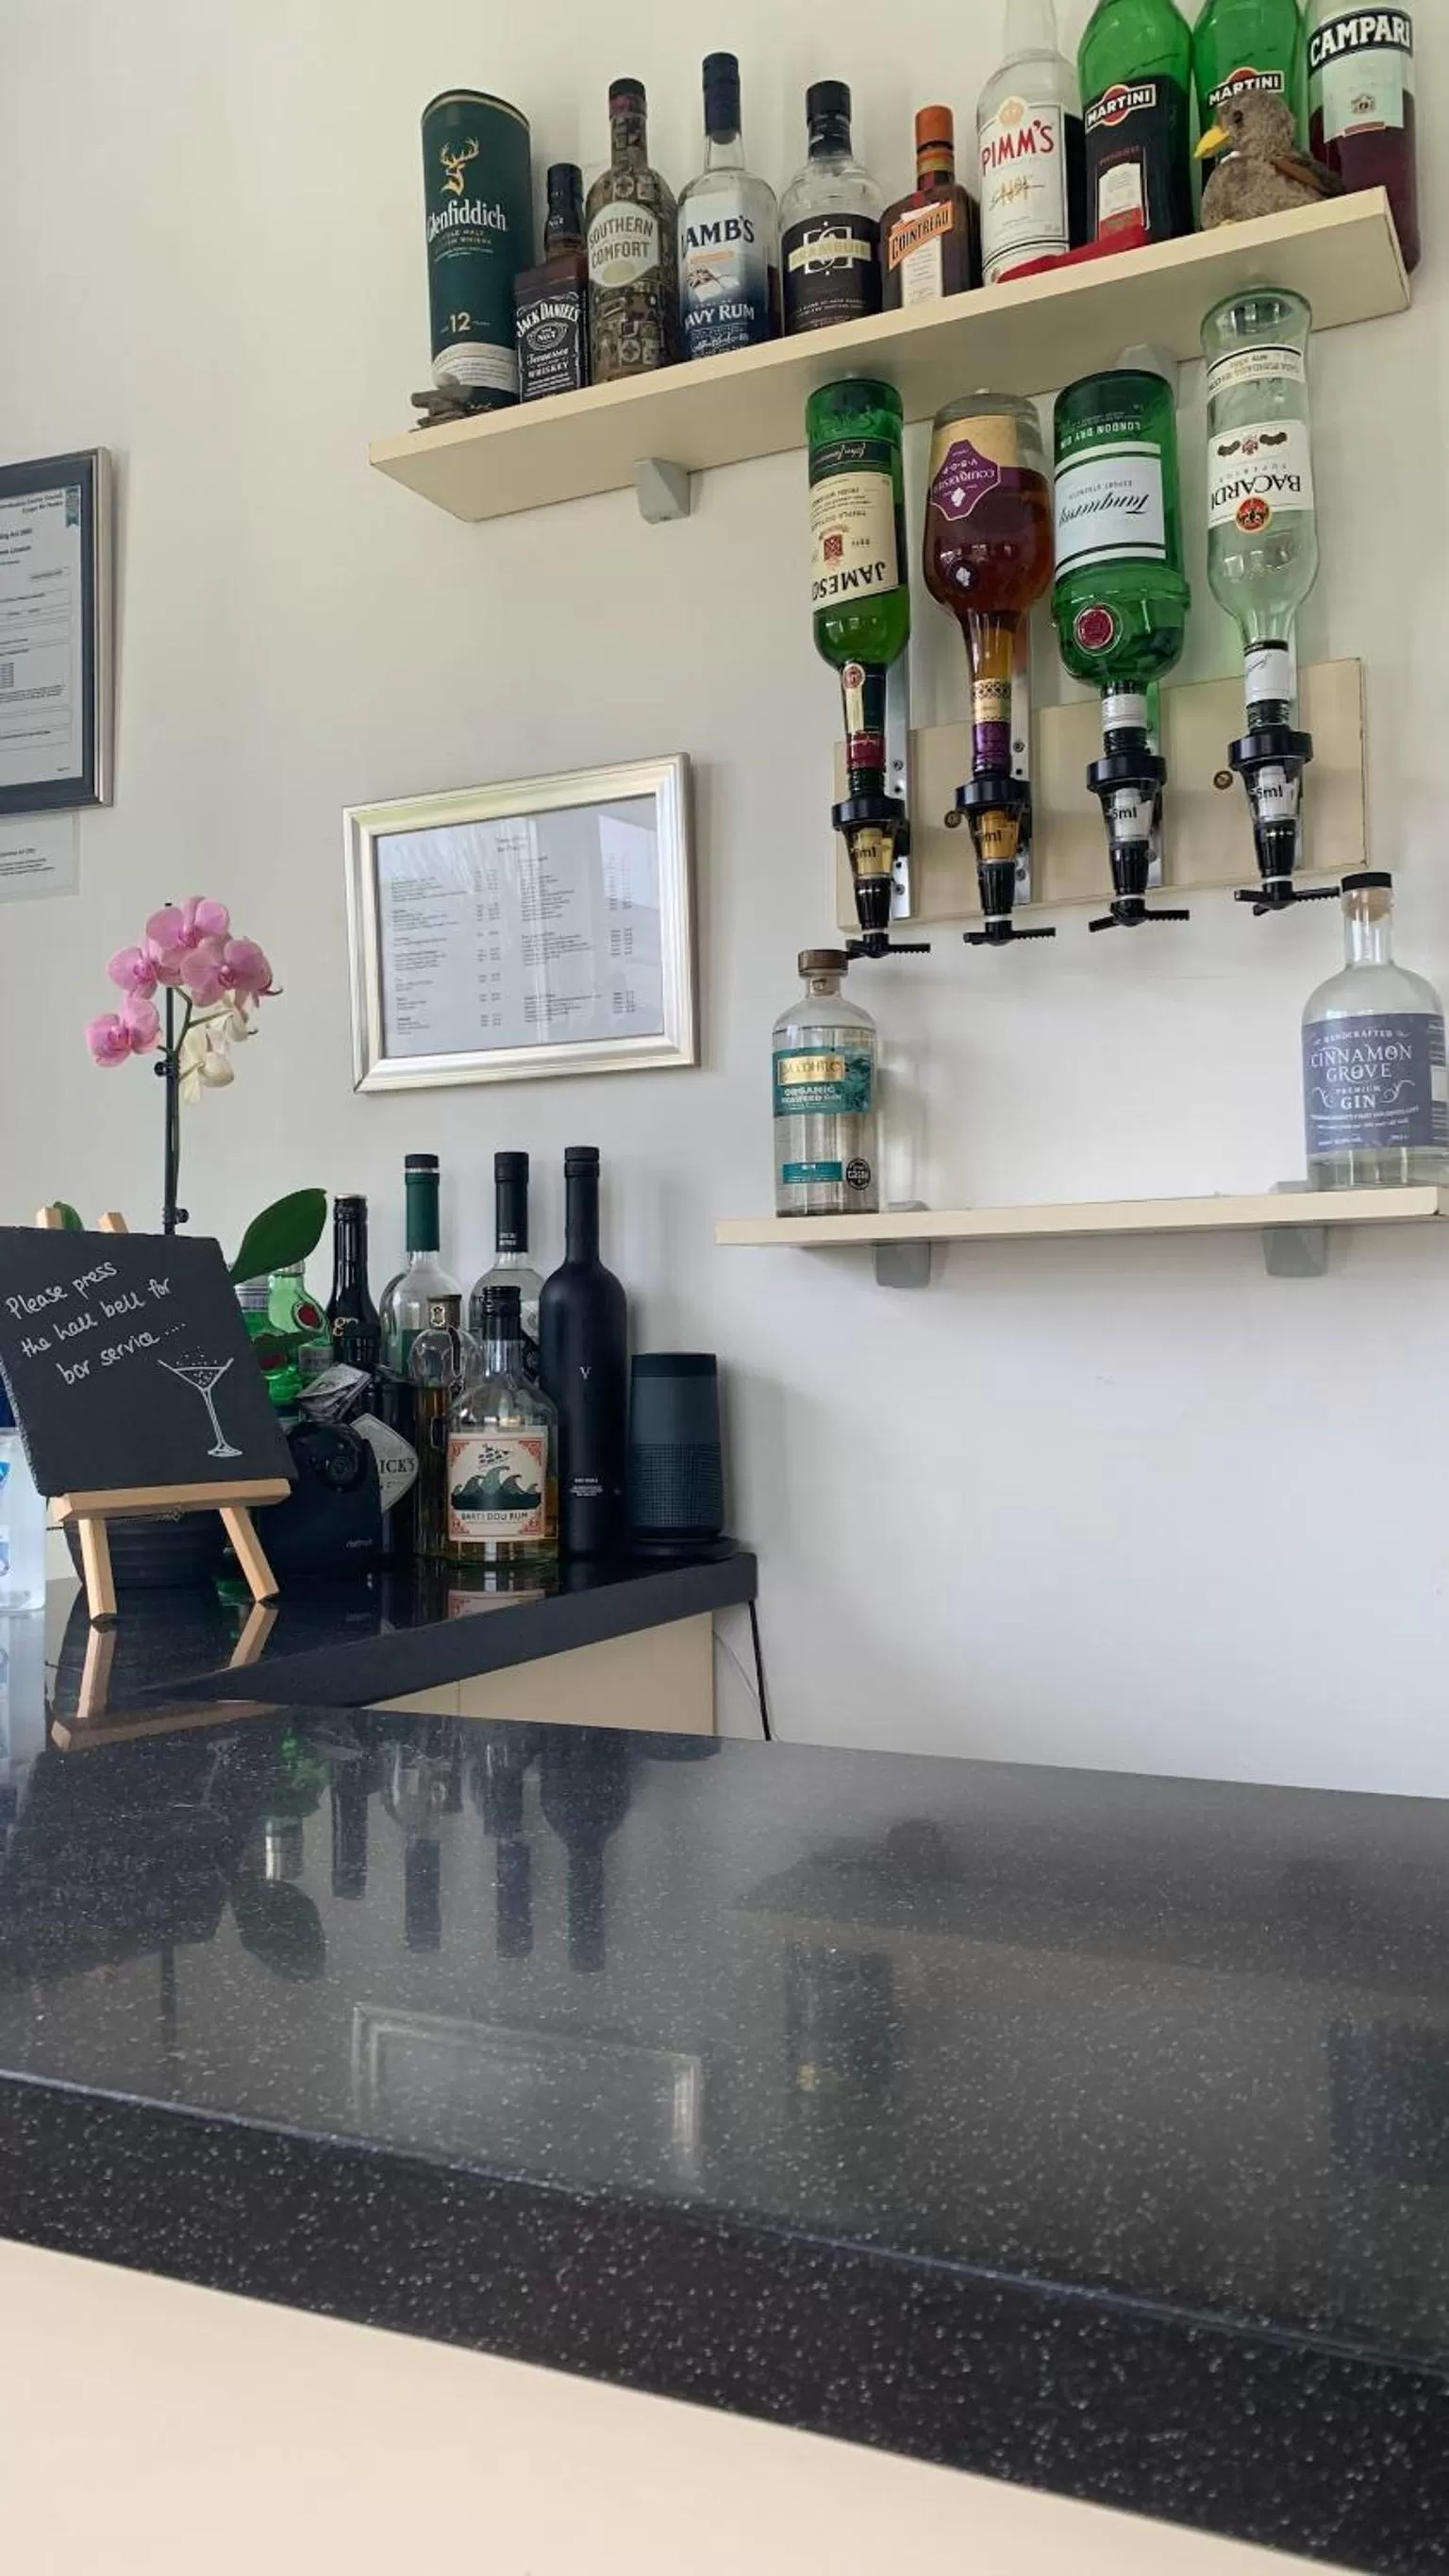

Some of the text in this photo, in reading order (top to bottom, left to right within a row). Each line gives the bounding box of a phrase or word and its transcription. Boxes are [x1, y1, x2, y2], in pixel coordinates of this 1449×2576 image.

[1310, 14, 1411, 67] CAMPARI
[1209, 75, 1279, 106] MARTINI
[1087, 90, 1151, 126] MARTINI
[980, 120, 1055, 176] PIMM'S
[588, 215, 654, 249] SOUTHERN
[891, 209, 949, 260] COINTREAU
[591, 241, 650, 269] COMFORT
[449, 311, 472, 333] 12
[516, 310, 541, 338] JACK
[719, 303, 755, 322] RUM
[1211, 475, 1302, 510] BACARDI
[1310, 1042, 1412, 1068] CINNAMON
[1325, 1062, 1392, 1083] GROVE
[784, 1085, 836, 1096] ORGANIC
[1340, 1095, 1376, 1111] GIN
[6, 1261, 118, 1320] Please press
[21, 1278, 171, 1359] the hall bell for
[56, 1360, 92, 1386] bar
